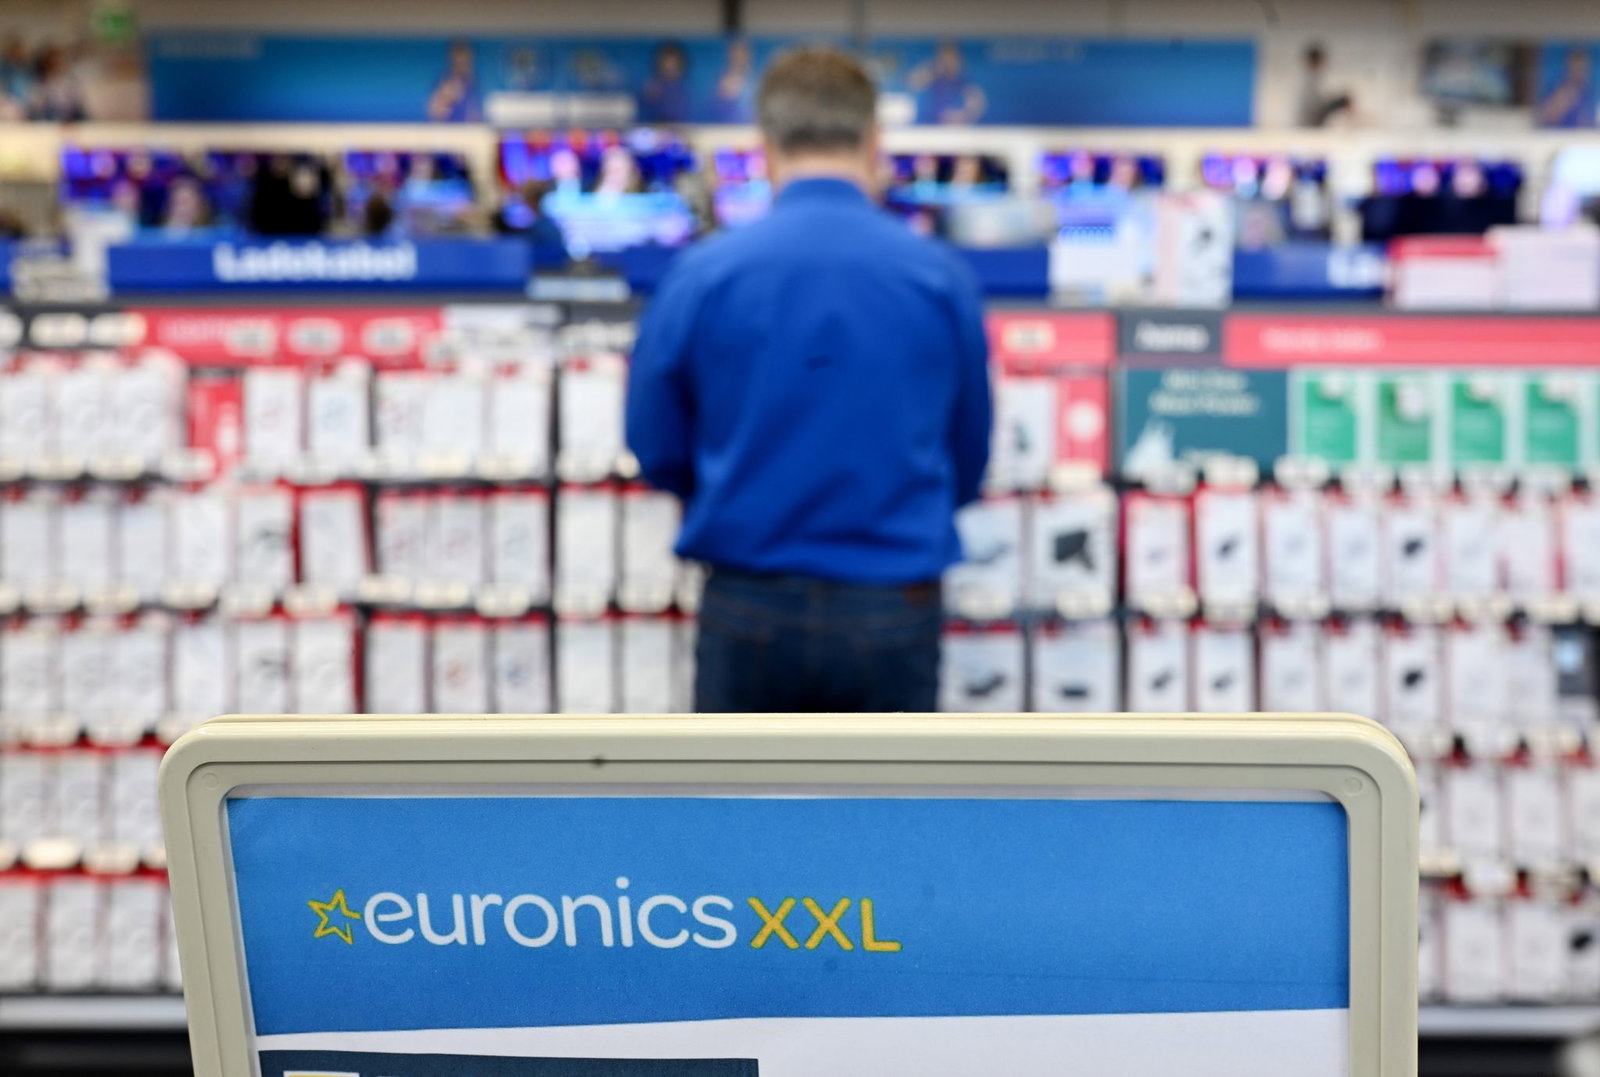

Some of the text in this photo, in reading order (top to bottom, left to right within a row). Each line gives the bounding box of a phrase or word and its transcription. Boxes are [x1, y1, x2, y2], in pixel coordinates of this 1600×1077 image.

[1328, 249, 1384, 288] La
[363, 876, 903, 953] euronics XXL
